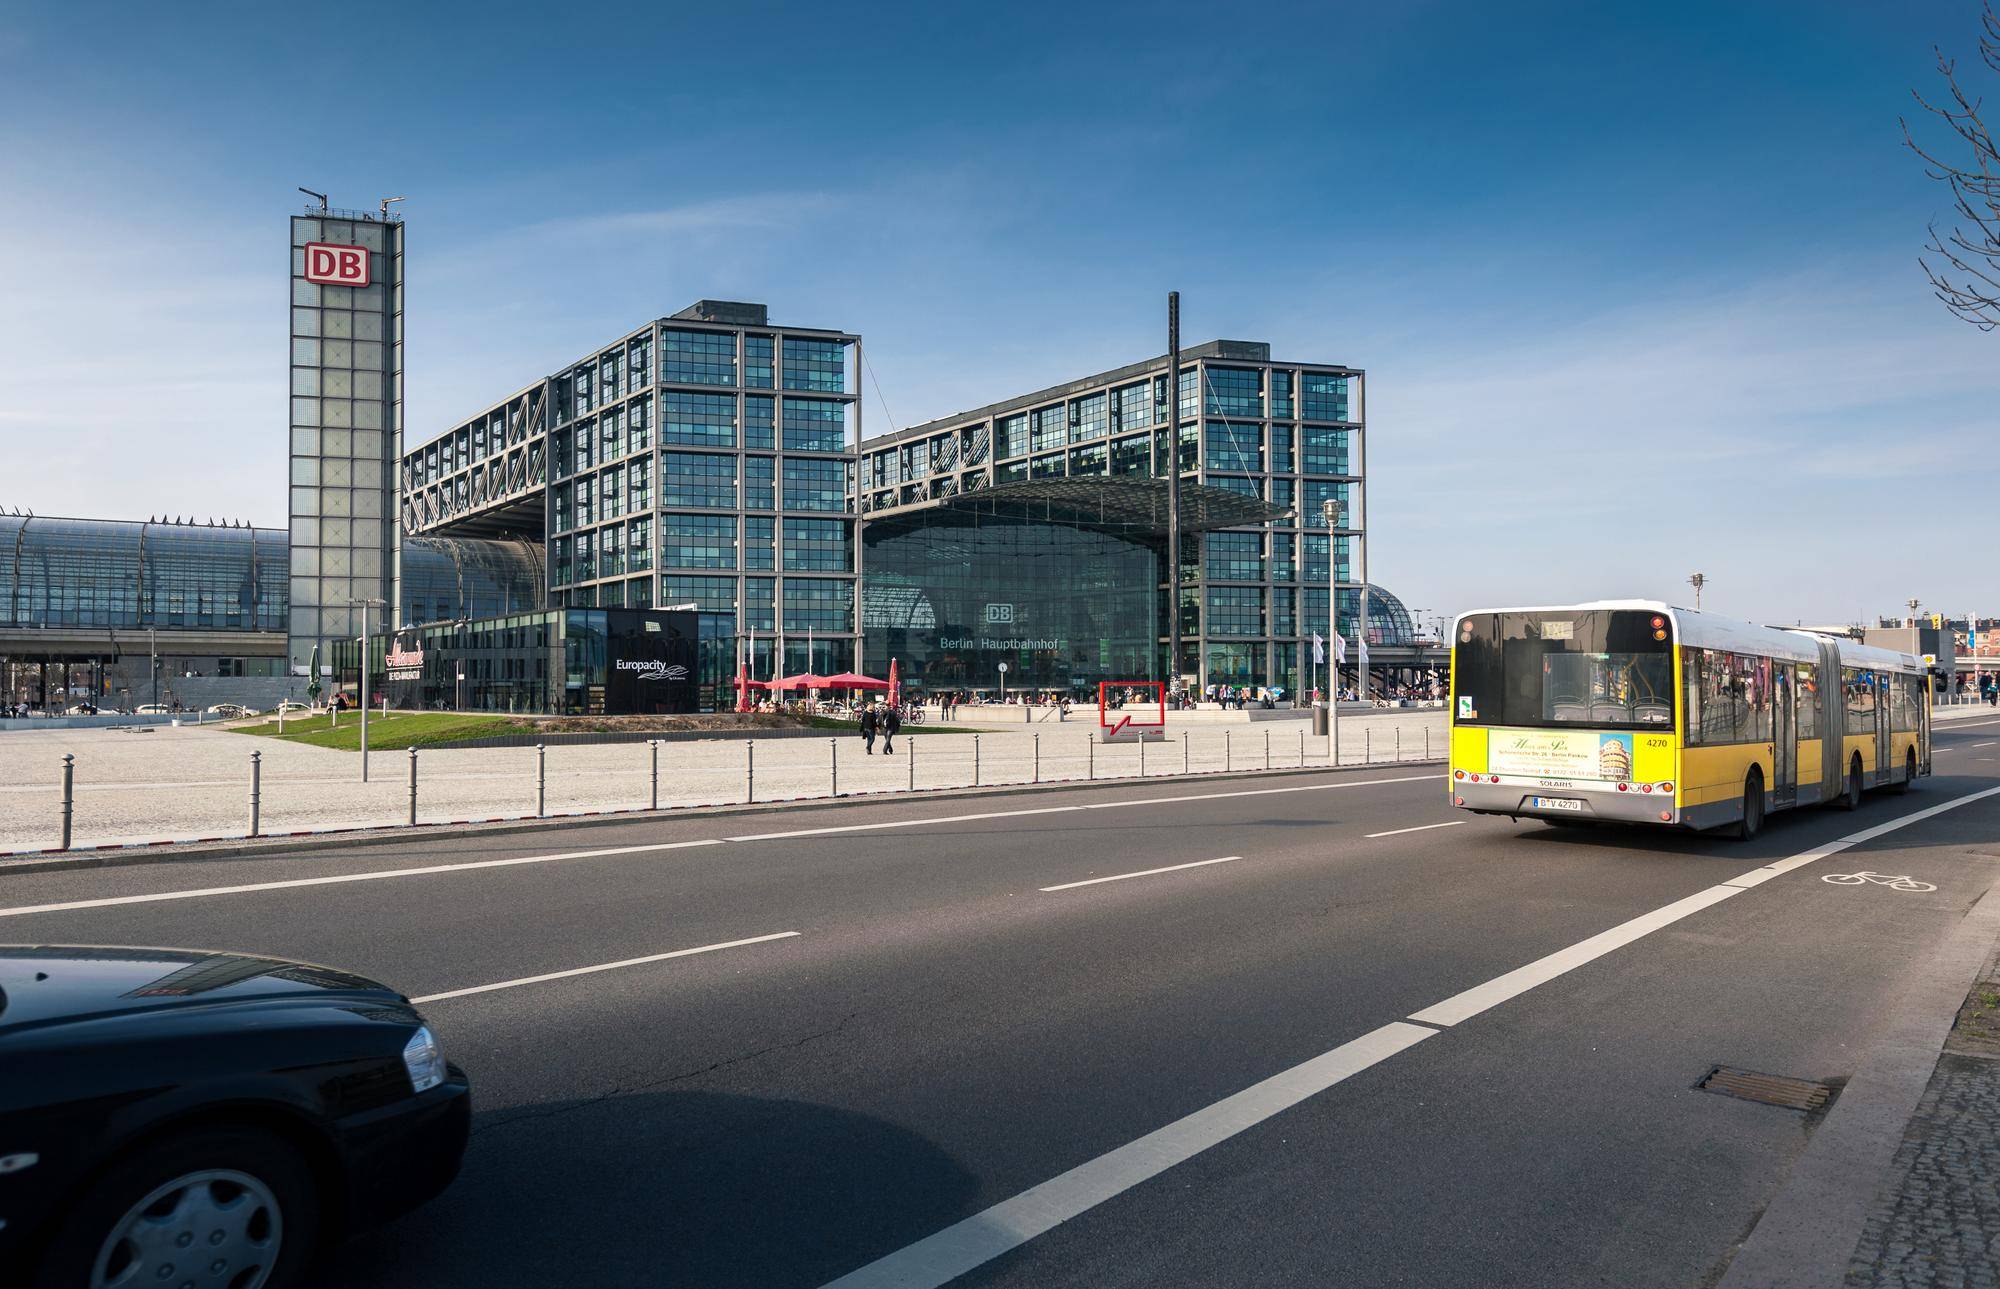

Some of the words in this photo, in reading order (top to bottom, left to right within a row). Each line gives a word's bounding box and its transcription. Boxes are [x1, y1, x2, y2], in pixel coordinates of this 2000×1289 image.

[313, 249, 361, 279] DB
[989, 606, 1010, 620] DB
[940, 638, 973, 649] Berlin
[981, 638, 1058, 651] Hauptbahnhof
[616, 660, 666, 672] Europacity
[1647, 739, 1668, 747] 4270
[1540, 780, 1573, 788] SOLARIS
[1541, 799, 1546, 807] B
[1551, 800, 1556, 808] V
[1558, 801, 1578, 810] 4270
